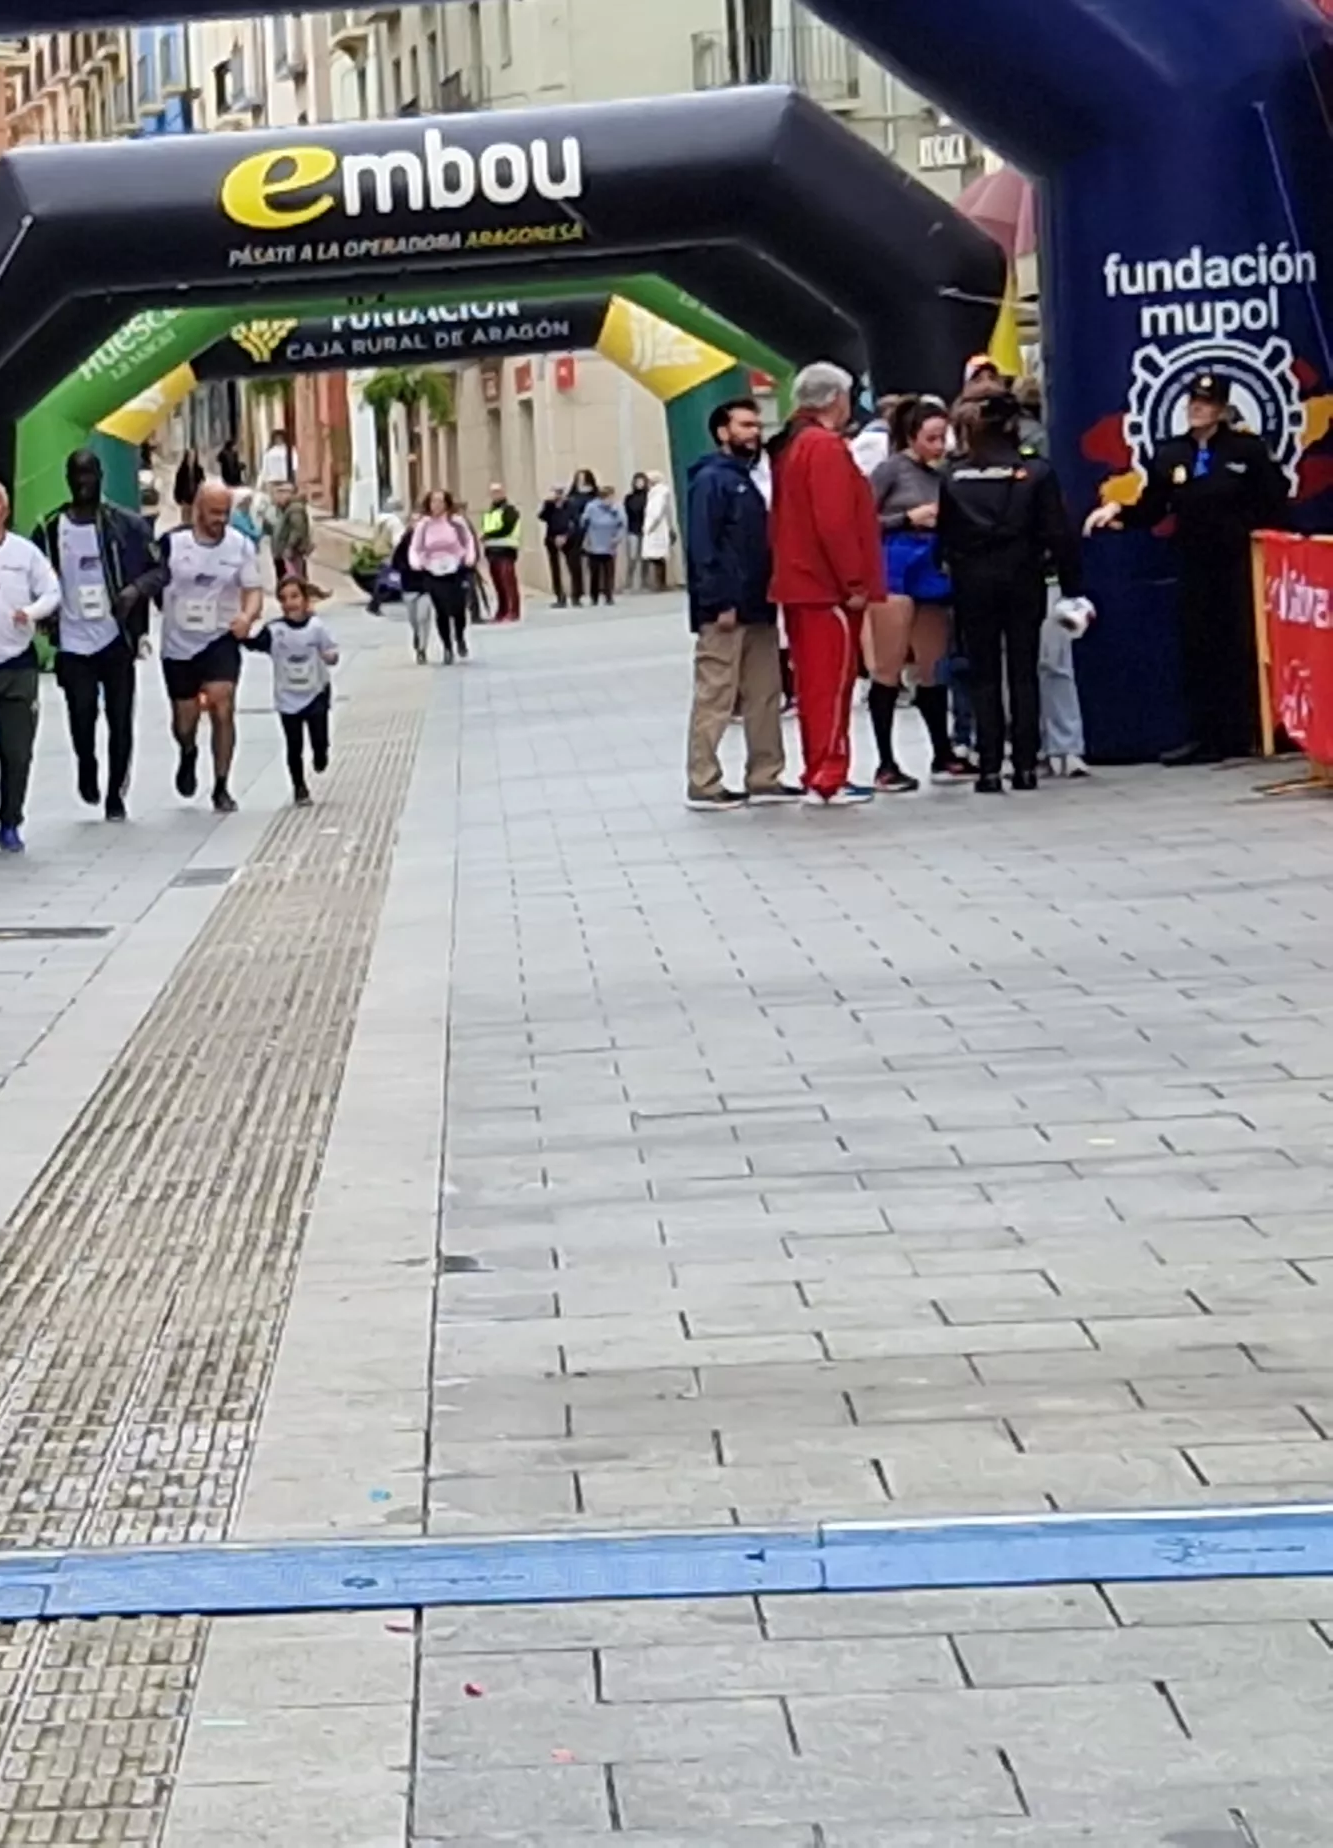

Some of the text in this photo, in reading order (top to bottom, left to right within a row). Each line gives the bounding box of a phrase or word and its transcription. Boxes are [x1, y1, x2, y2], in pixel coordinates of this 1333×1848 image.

[220, 128, 583, 229] embou
[227, 222, 584, 267] PÁSATE A LA OPERADORA ARAGONESA
[1103, 242, 1317, 297] fundación
[285, 319, 570, 361] CAJA RURAL DE ARAGÓN
[1140, 285, 1279, 342] mupol
